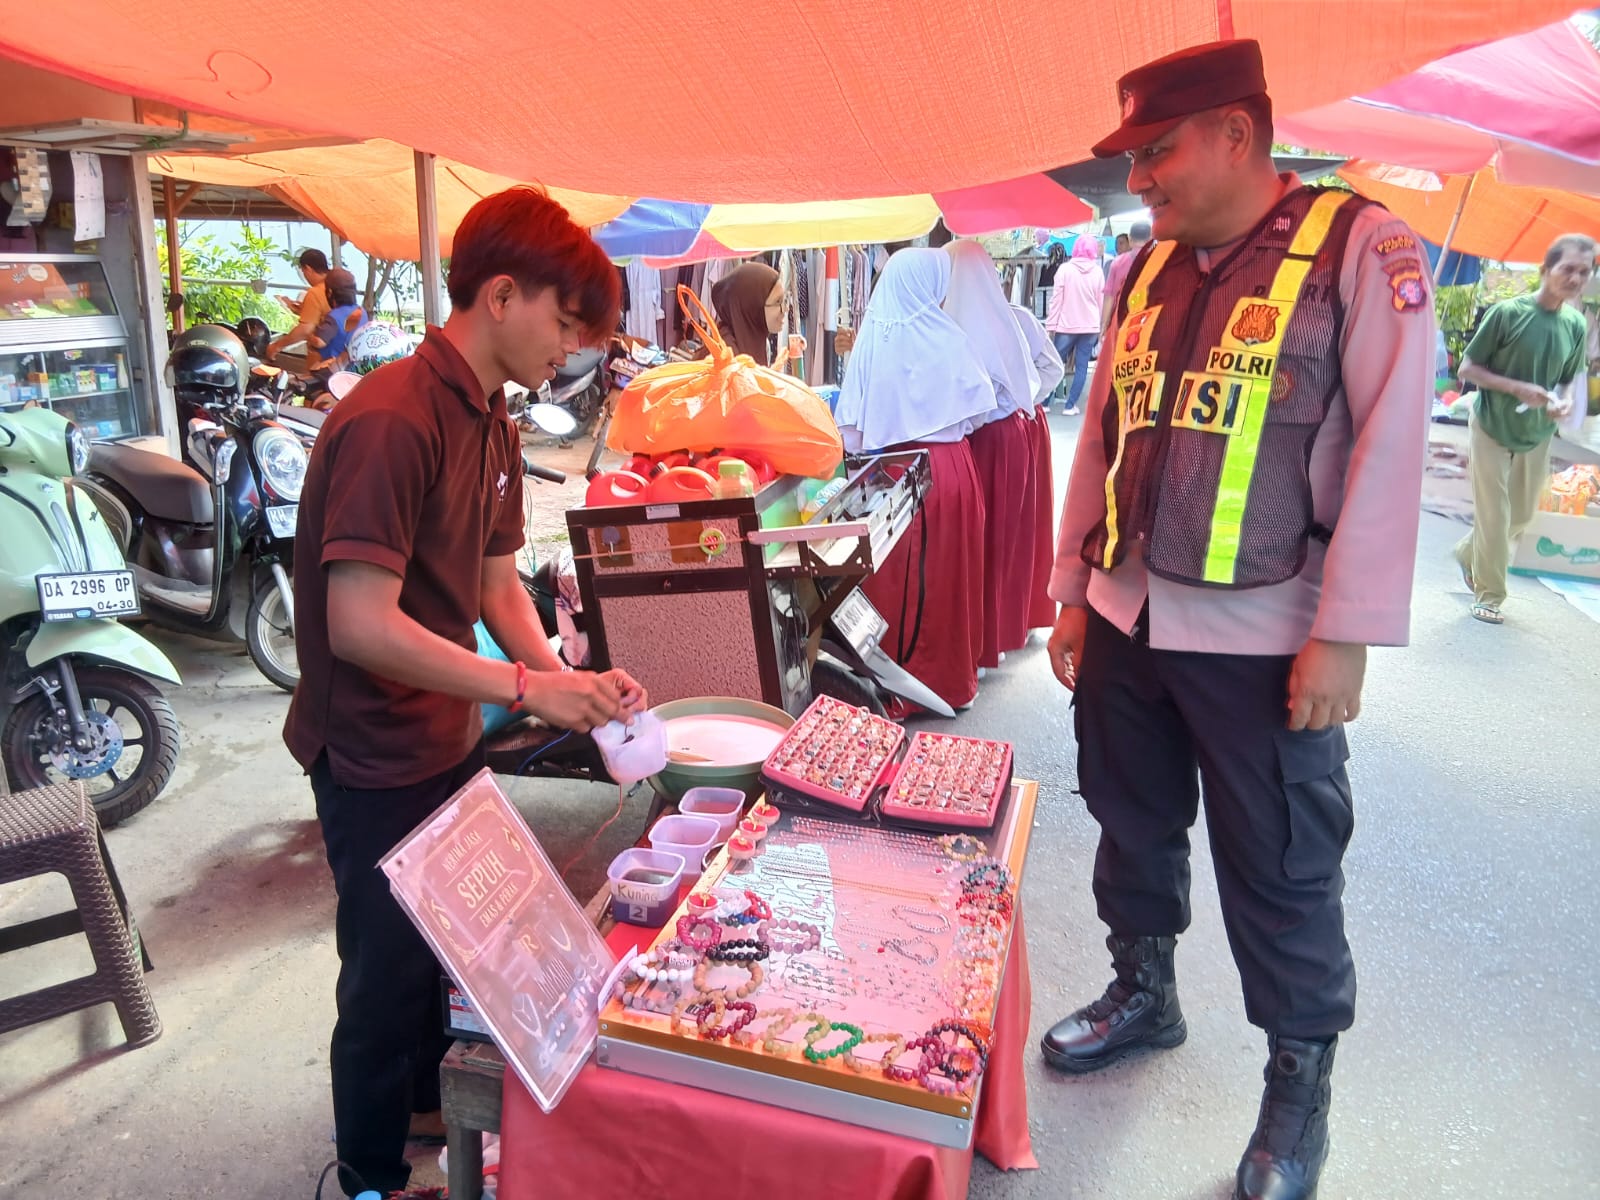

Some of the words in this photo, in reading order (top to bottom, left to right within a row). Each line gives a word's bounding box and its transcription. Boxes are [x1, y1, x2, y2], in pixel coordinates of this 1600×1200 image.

[1209, 351, 1273, 376] POLRI
[44, 582, 63, 597] DA
[71, 579, 105, 596] 2996
[115, 577, 130, 592] OP
[97, 600, 133, 610] 04-30
[457, 850, 506, 908] SEPUH
[480, 908, 499, 928] EMAS
[632, 906, 643, 918] 2
